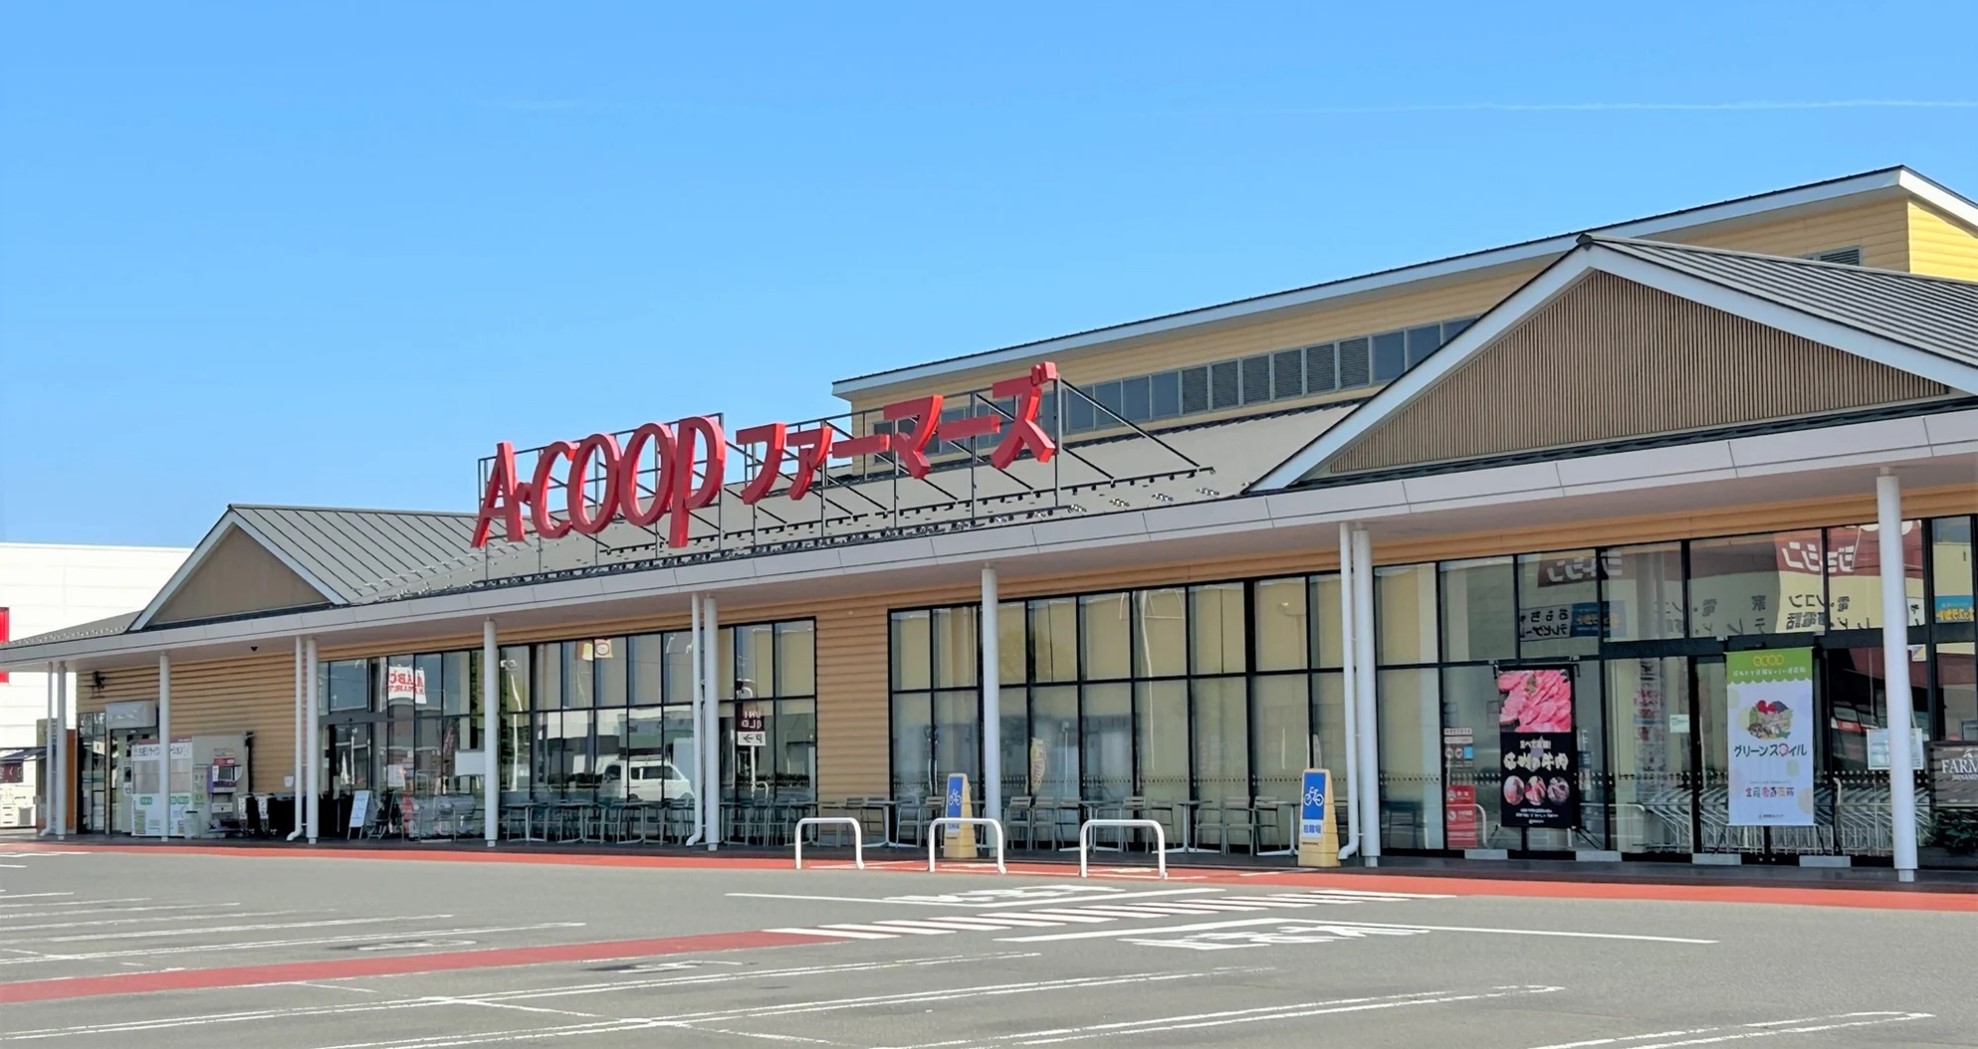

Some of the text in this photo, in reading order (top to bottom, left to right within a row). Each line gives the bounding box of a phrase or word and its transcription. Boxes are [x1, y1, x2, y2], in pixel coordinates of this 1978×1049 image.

[736, 361, 1057, 504] ファーマーズ
